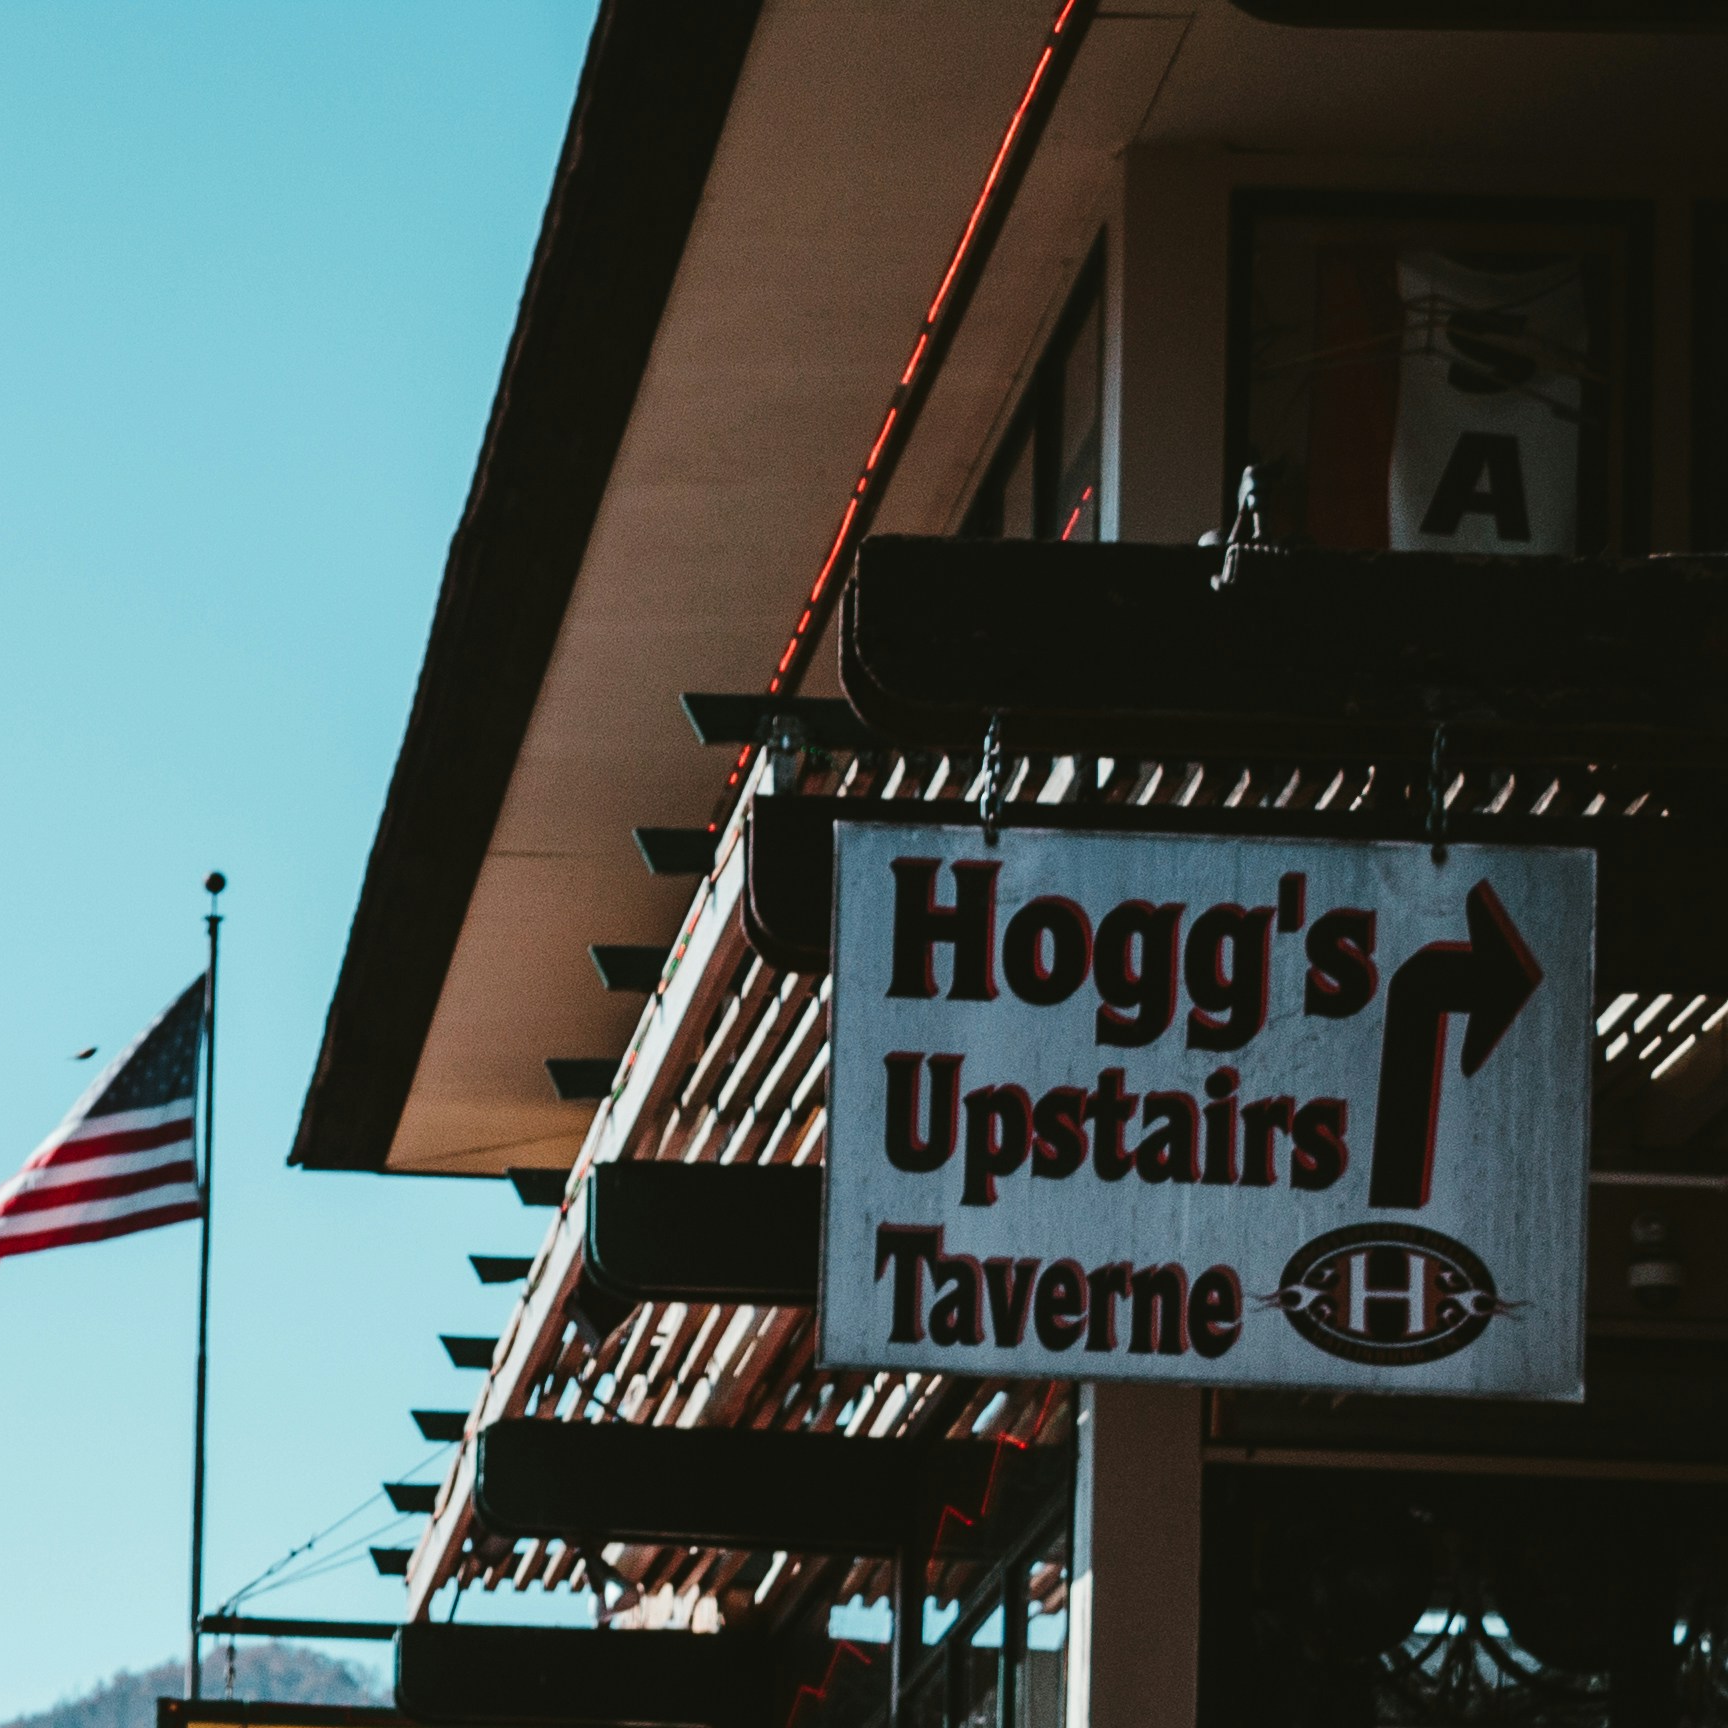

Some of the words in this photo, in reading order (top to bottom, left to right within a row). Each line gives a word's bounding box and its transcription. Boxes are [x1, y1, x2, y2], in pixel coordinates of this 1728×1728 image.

[1420, 307, 1538, 542] SA
[885, 855, 1379, 1051] Hogg's
[883, 1050, 1350, 1207] Upstairs
[875, 1221, 1246, 1360] Taverne
